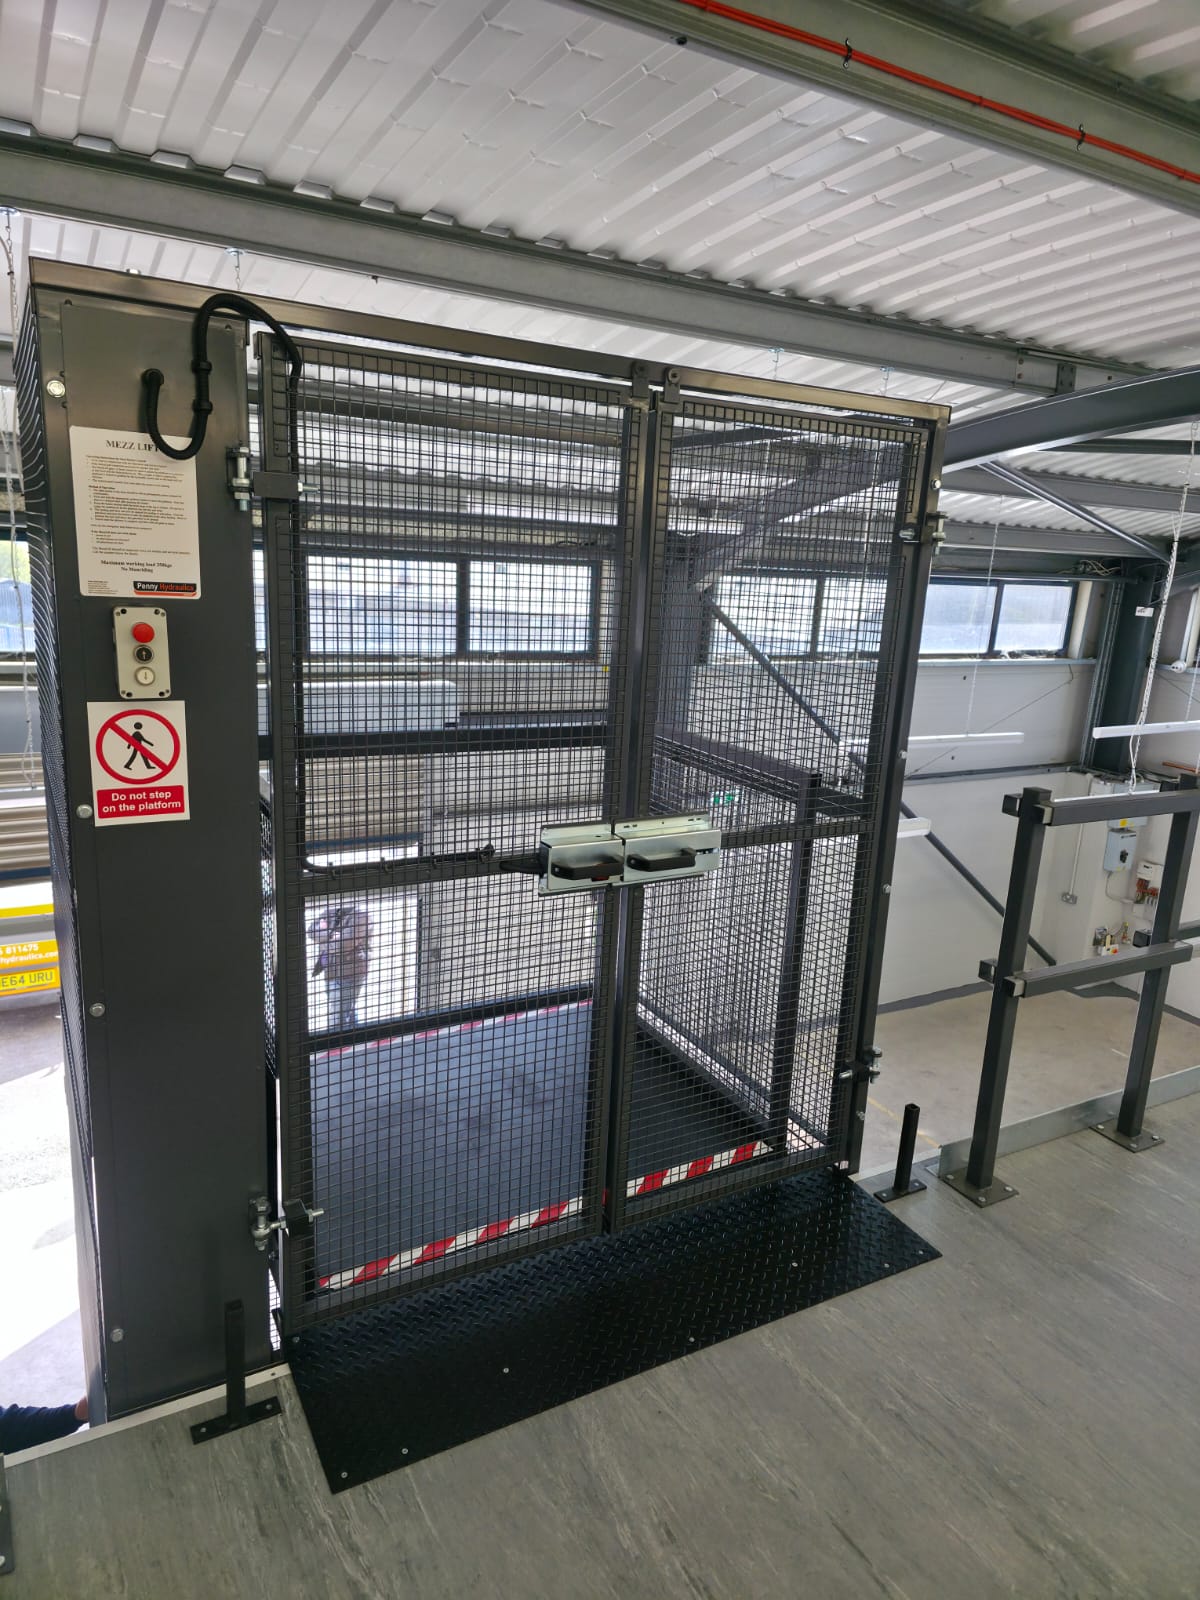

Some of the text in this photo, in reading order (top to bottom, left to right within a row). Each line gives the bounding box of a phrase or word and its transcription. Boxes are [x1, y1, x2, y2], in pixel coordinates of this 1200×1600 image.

[106, 440, 135, 450] MEZZ
[137, 583, 194, 591] Penny Hydraulics
[111, 792, 171, 801] Do not step
[119, 803, 136, 812] the
[139, 802, 181, 812] platform
[29, 971, 53, 984] URU
